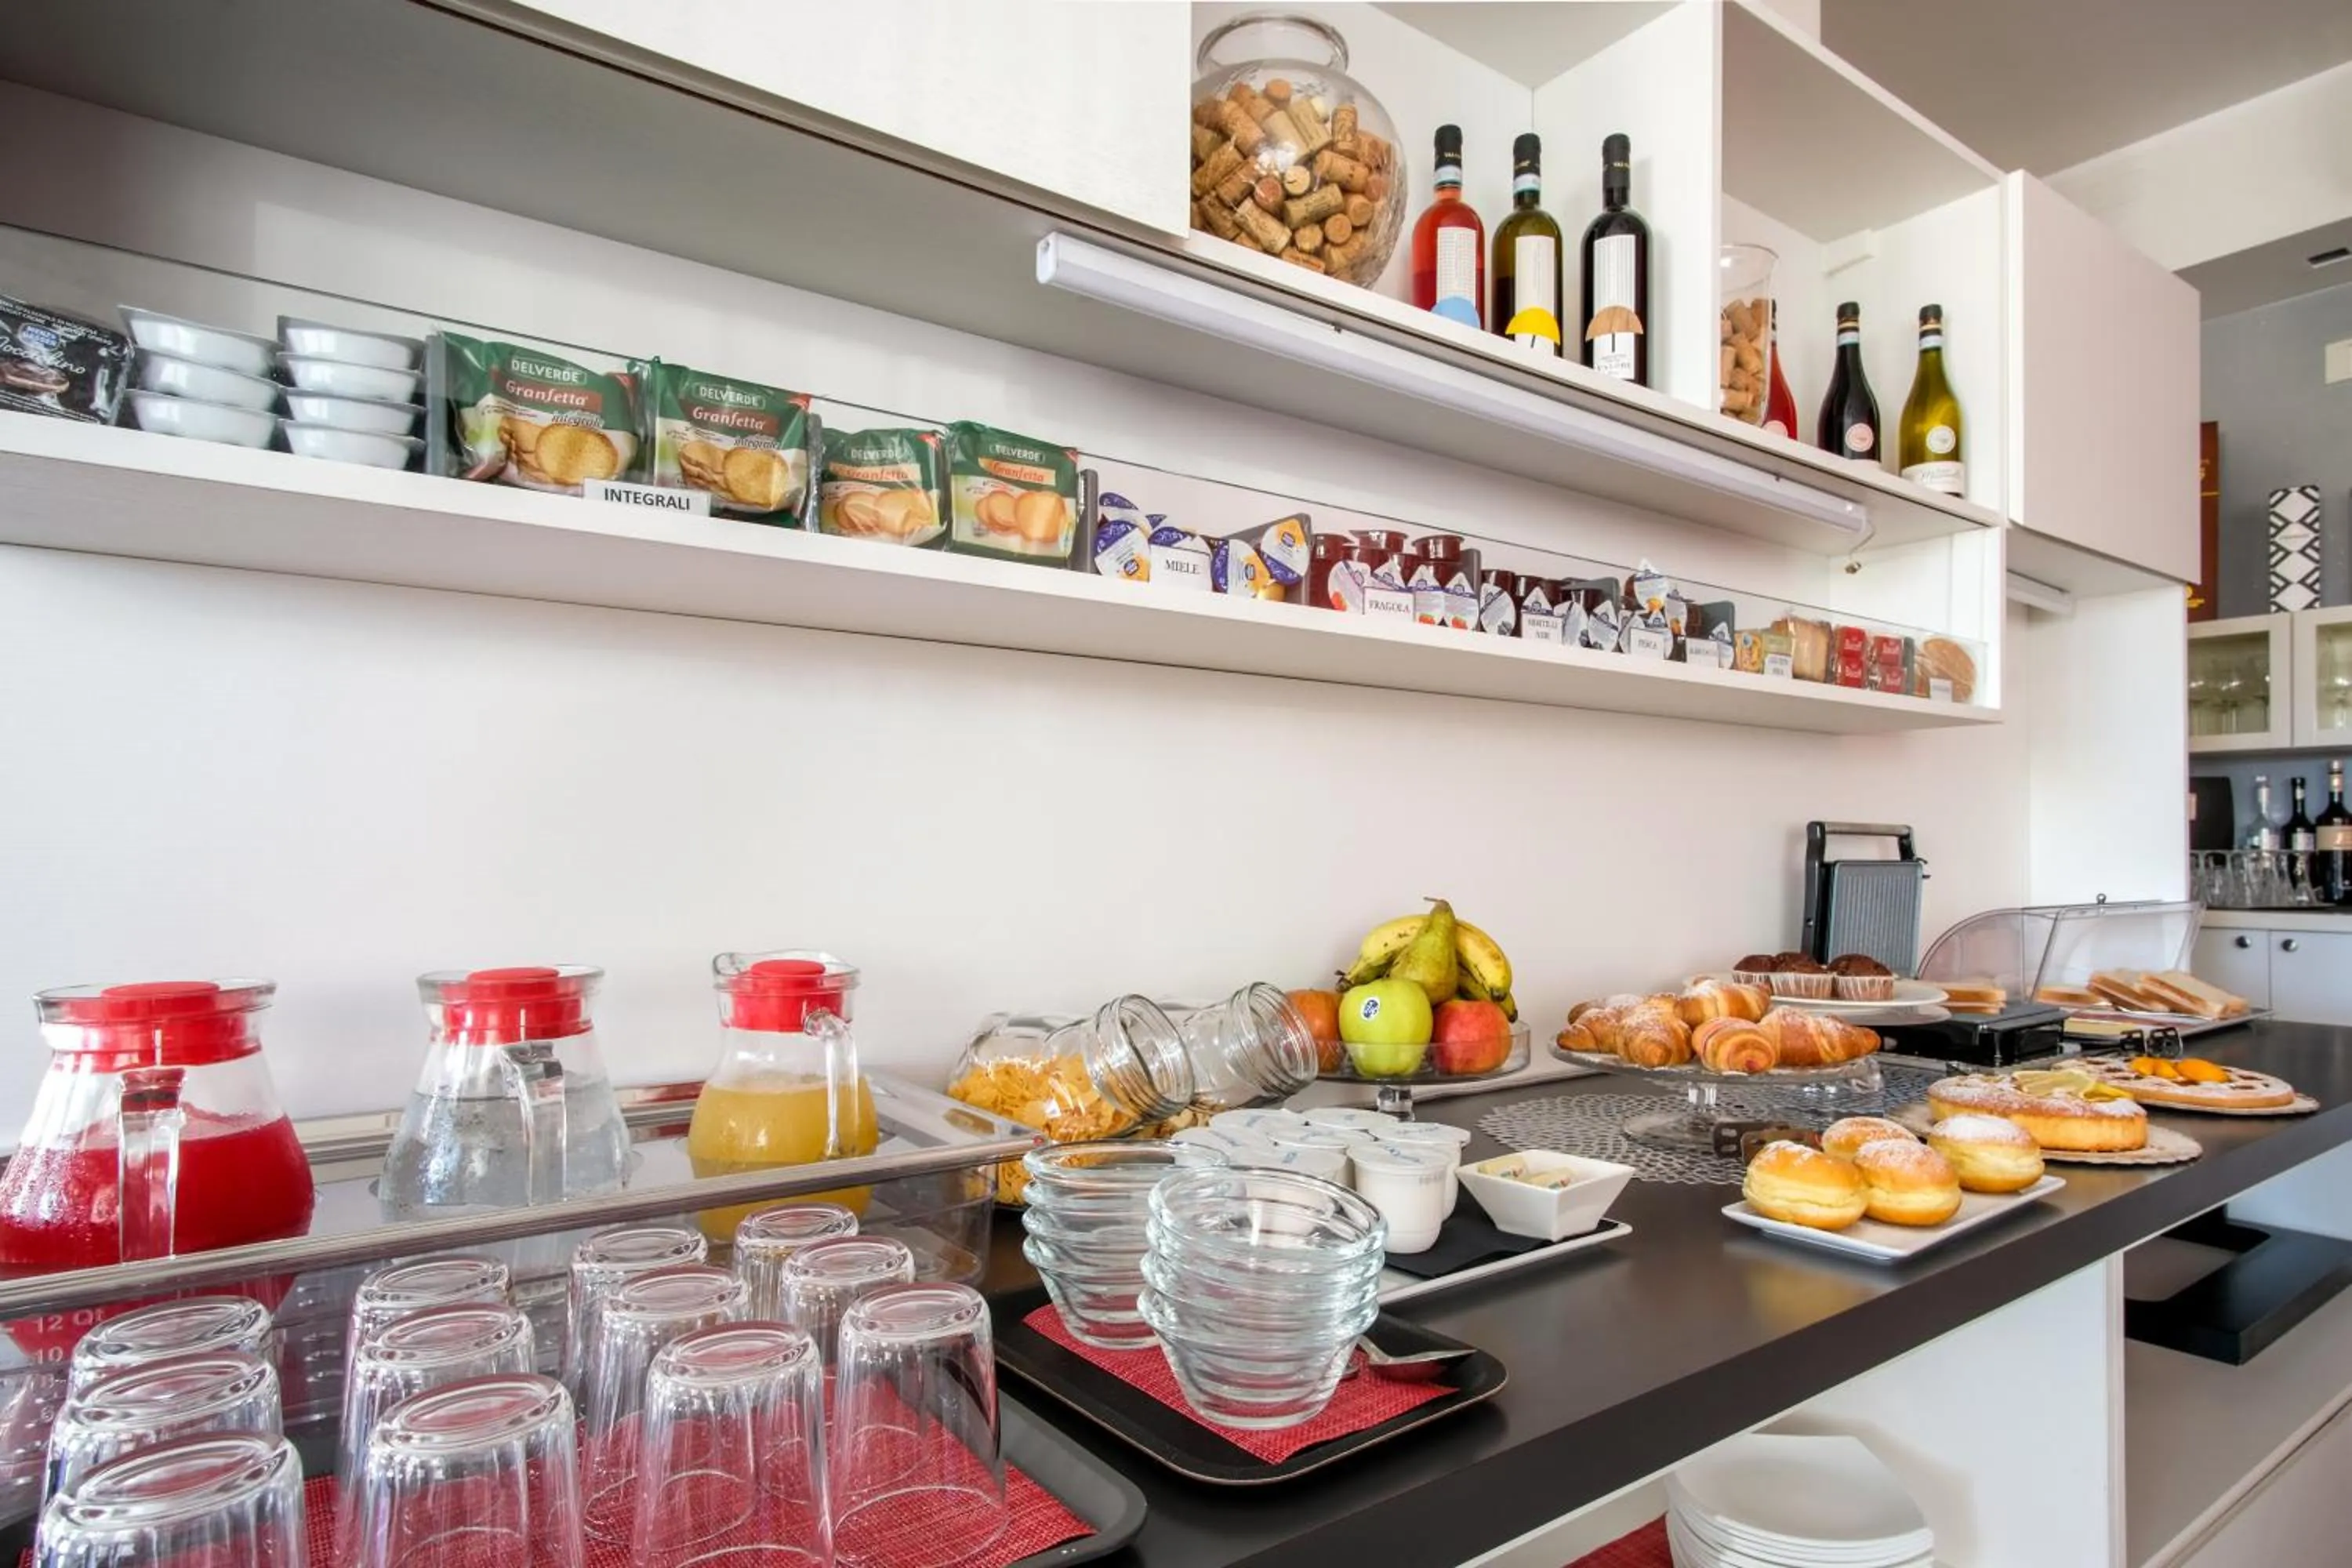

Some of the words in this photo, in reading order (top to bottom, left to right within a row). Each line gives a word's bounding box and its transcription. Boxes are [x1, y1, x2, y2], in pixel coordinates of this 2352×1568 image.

[511, 360, 579, 383] DELVERDE
[506, 380, 586, 405] Granfetta
[700, 387, 760, 407] DELVERDE
[693, 407, 764, 430] Granfetta
[604, 487, 690, 510] INTEGRALI
[1166, 560, 1200, 574] MIELE
[1369, 600, 1410, 612] FRAGOLA
[37, 1314, 64, 1333] 12
[34, 1345, 64, 1364] 10
